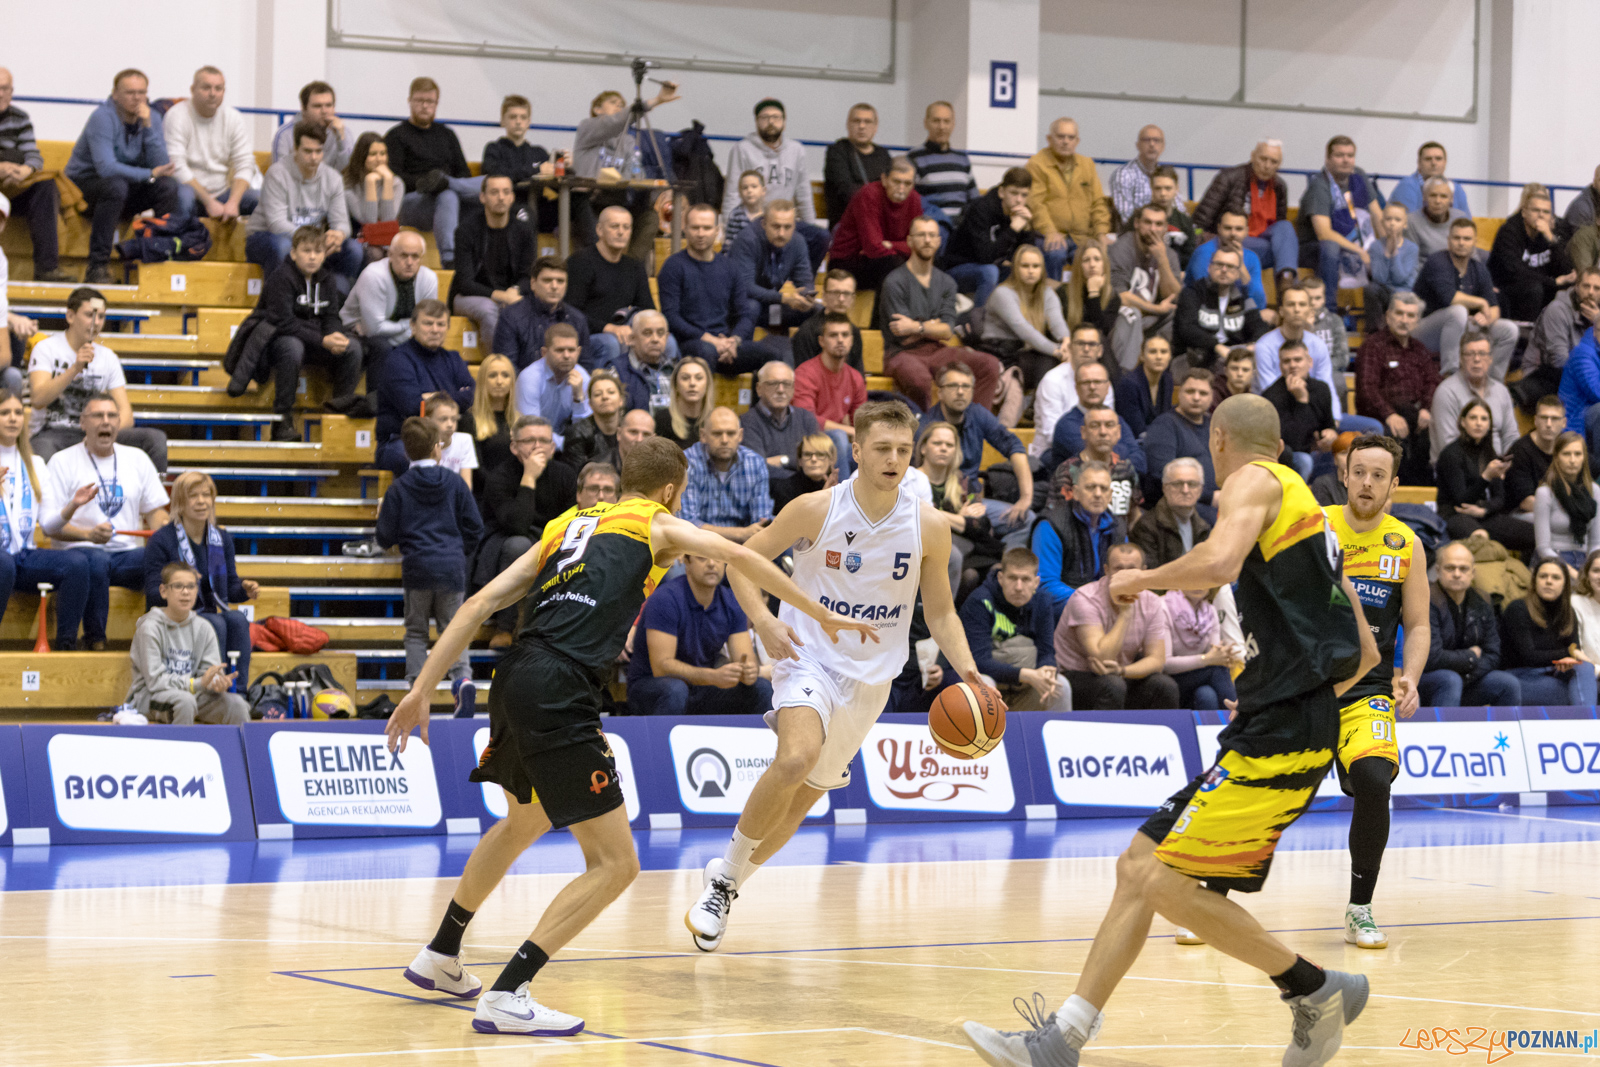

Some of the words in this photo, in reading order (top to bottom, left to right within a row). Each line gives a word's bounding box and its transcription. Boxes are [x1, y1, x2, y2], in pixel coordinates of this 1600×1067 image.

[994, 68, 1014, 101] B
[557, 516, 601, 573] 9
[892, 552, 912, 580] 5
[1379, 554, 1401, 580] 91
[565, 591, 597, 607] Polska
[26, 674, 37, 684] 12
[1371, 719, 1393, 743] 91
[299, 744, 405, 773] HELMEX
[919, 740, 944, 755] len
[919, 757, 989, 780] Danuty
[1399, 744, 1507, 779] OZnan
[304, 777, 409, 797] EXHIBITIONS
[307, 805, 350, 817] AGENCJA
[352, 804, 413, 816] REKLAMOWA
